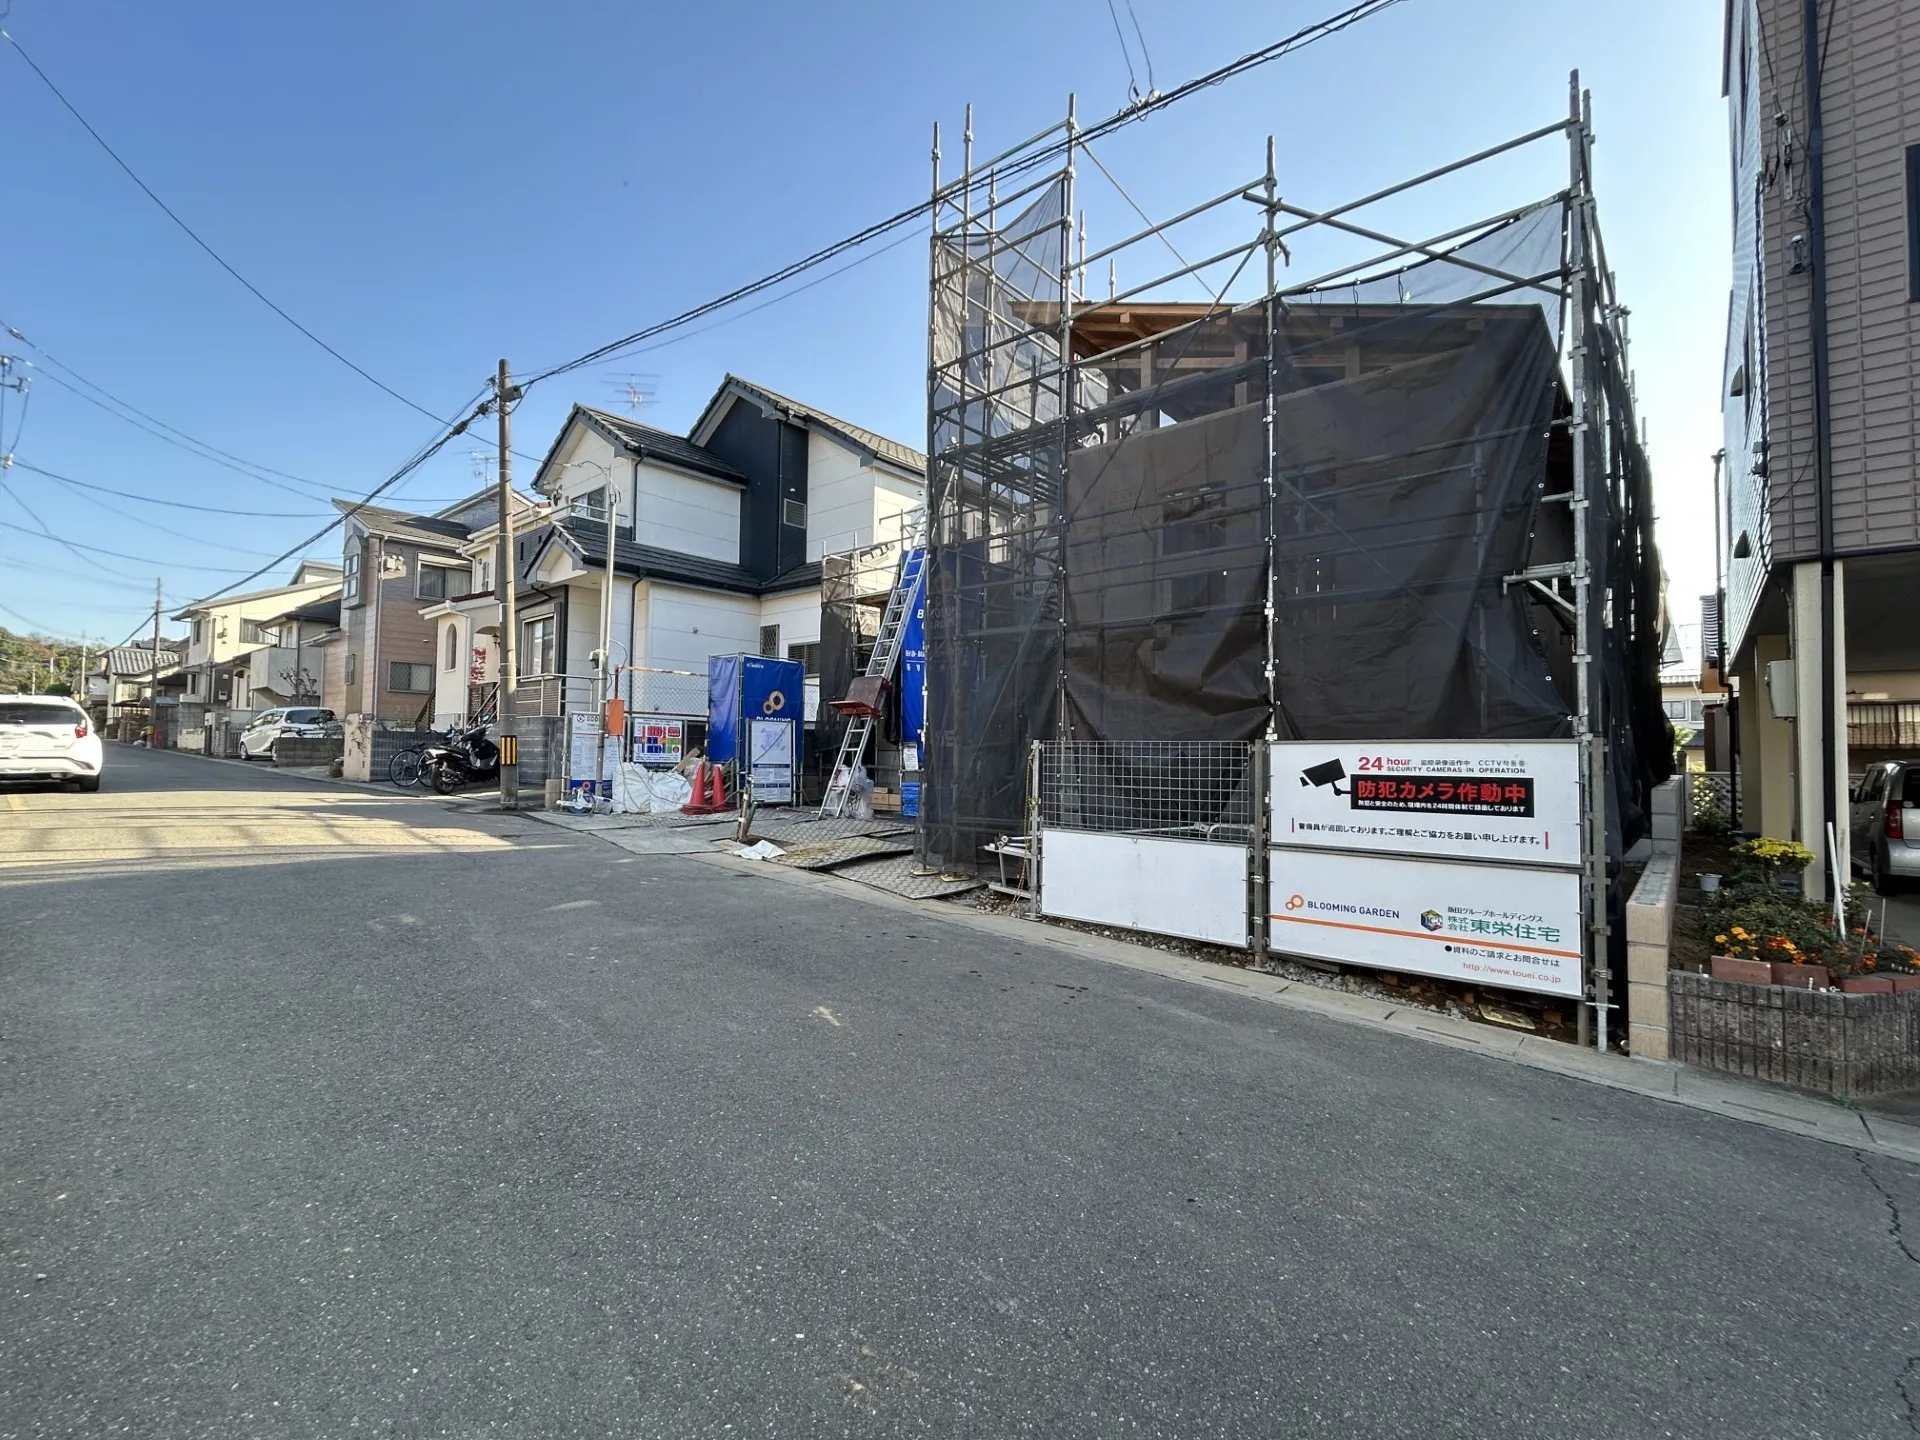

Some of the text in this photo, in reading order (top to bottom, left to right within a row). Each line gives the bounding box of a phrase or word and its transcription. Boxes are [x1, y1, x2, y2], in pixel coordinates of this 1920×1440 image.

[1358, 757, 1383, 771] 24
[1387, 757, 1411, 766] hour
[1357, 780, 1526, 803] 防犯カメラ作動中
[1307, 901, 1400, 919] BLOOMING GARDEN
[1447, 906, 1544, 922] 飯田グループホールディングス
[1447, 915, 1469, 925] 株式
[1447, 924, 1469, 932] 会社
[1470, 919, 1561, 943] 東栄住宅
[1463, 962, 1561, 983] http://www.touei.co.jp
